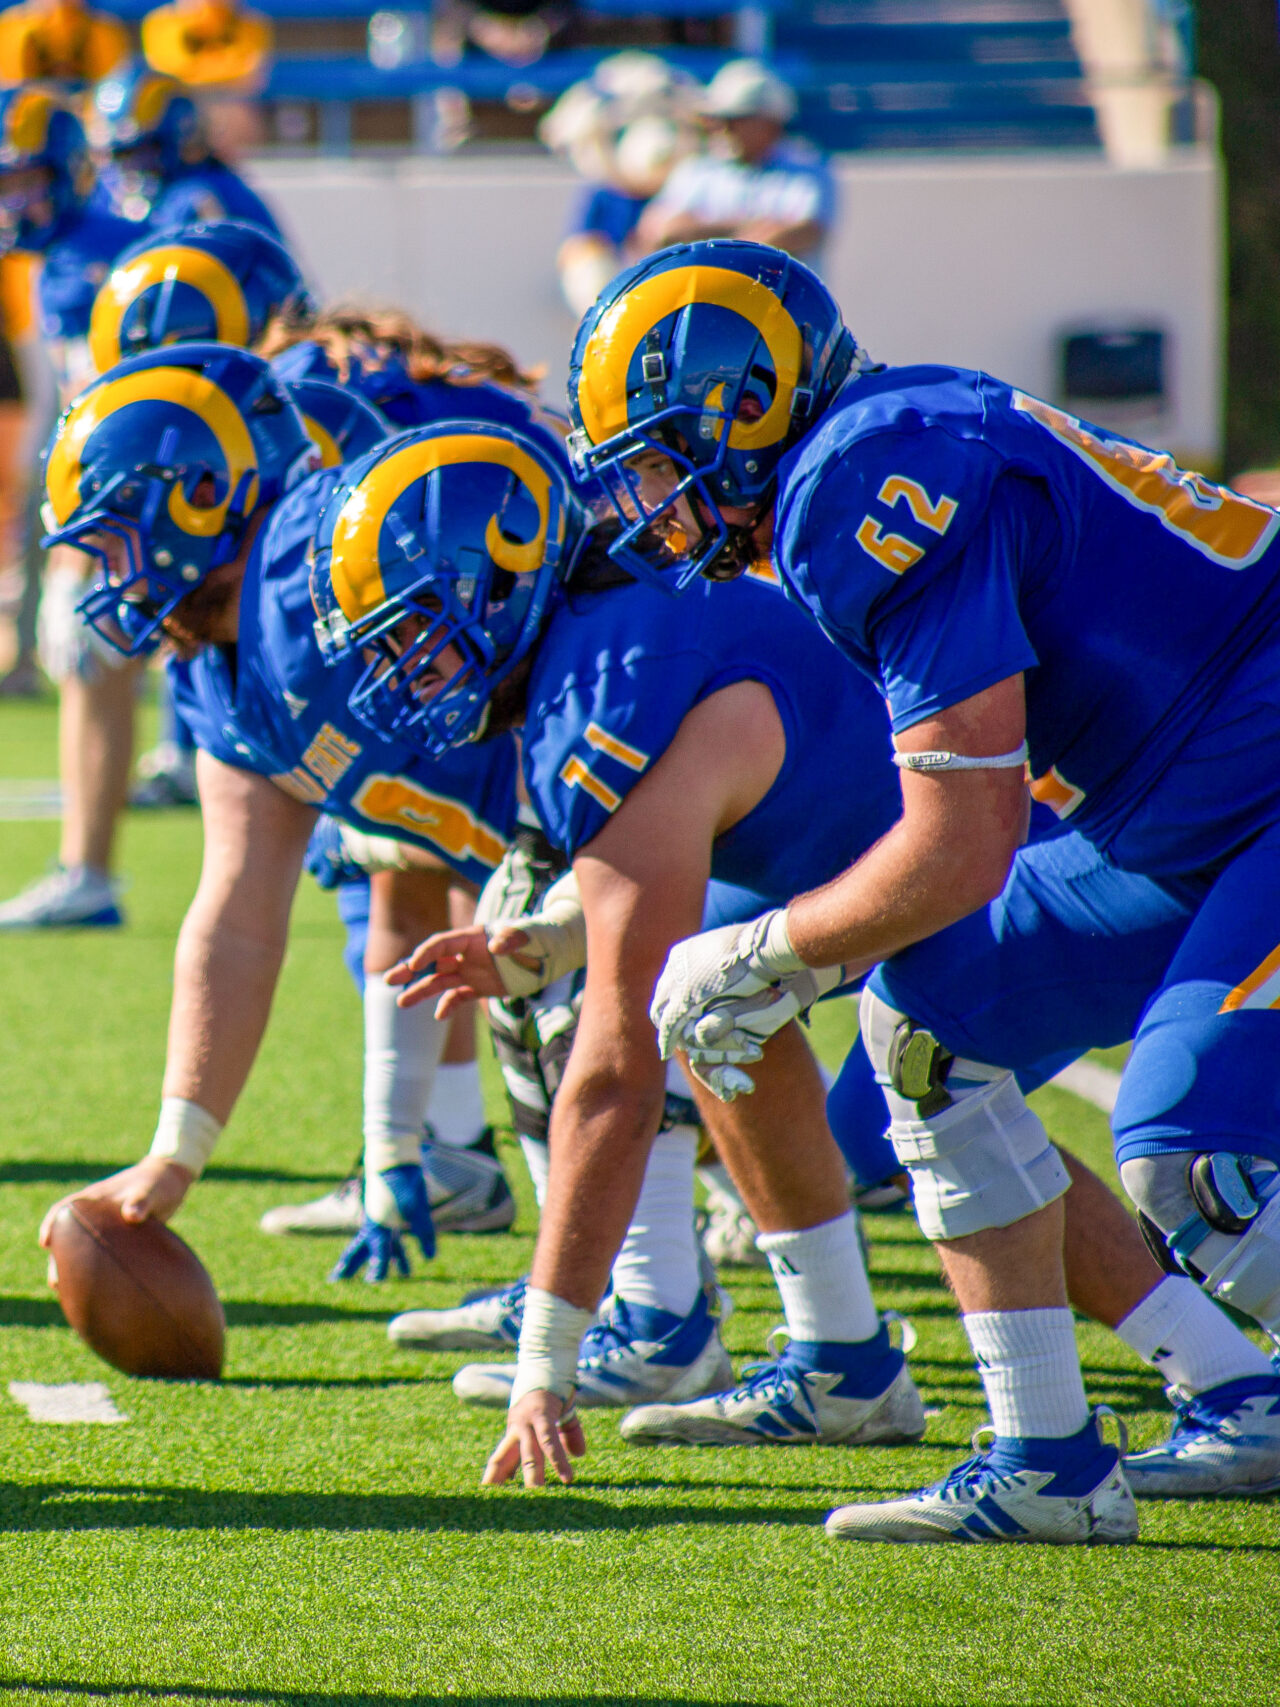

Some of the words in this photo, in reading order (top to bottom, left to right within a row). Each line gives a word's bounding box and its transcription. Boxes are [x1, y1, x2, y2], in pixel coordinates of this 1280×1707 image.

[855, 474, 959, 575] 62
[301, 723, 362, 790] STATE
[559, 721, 650, 812] 71
